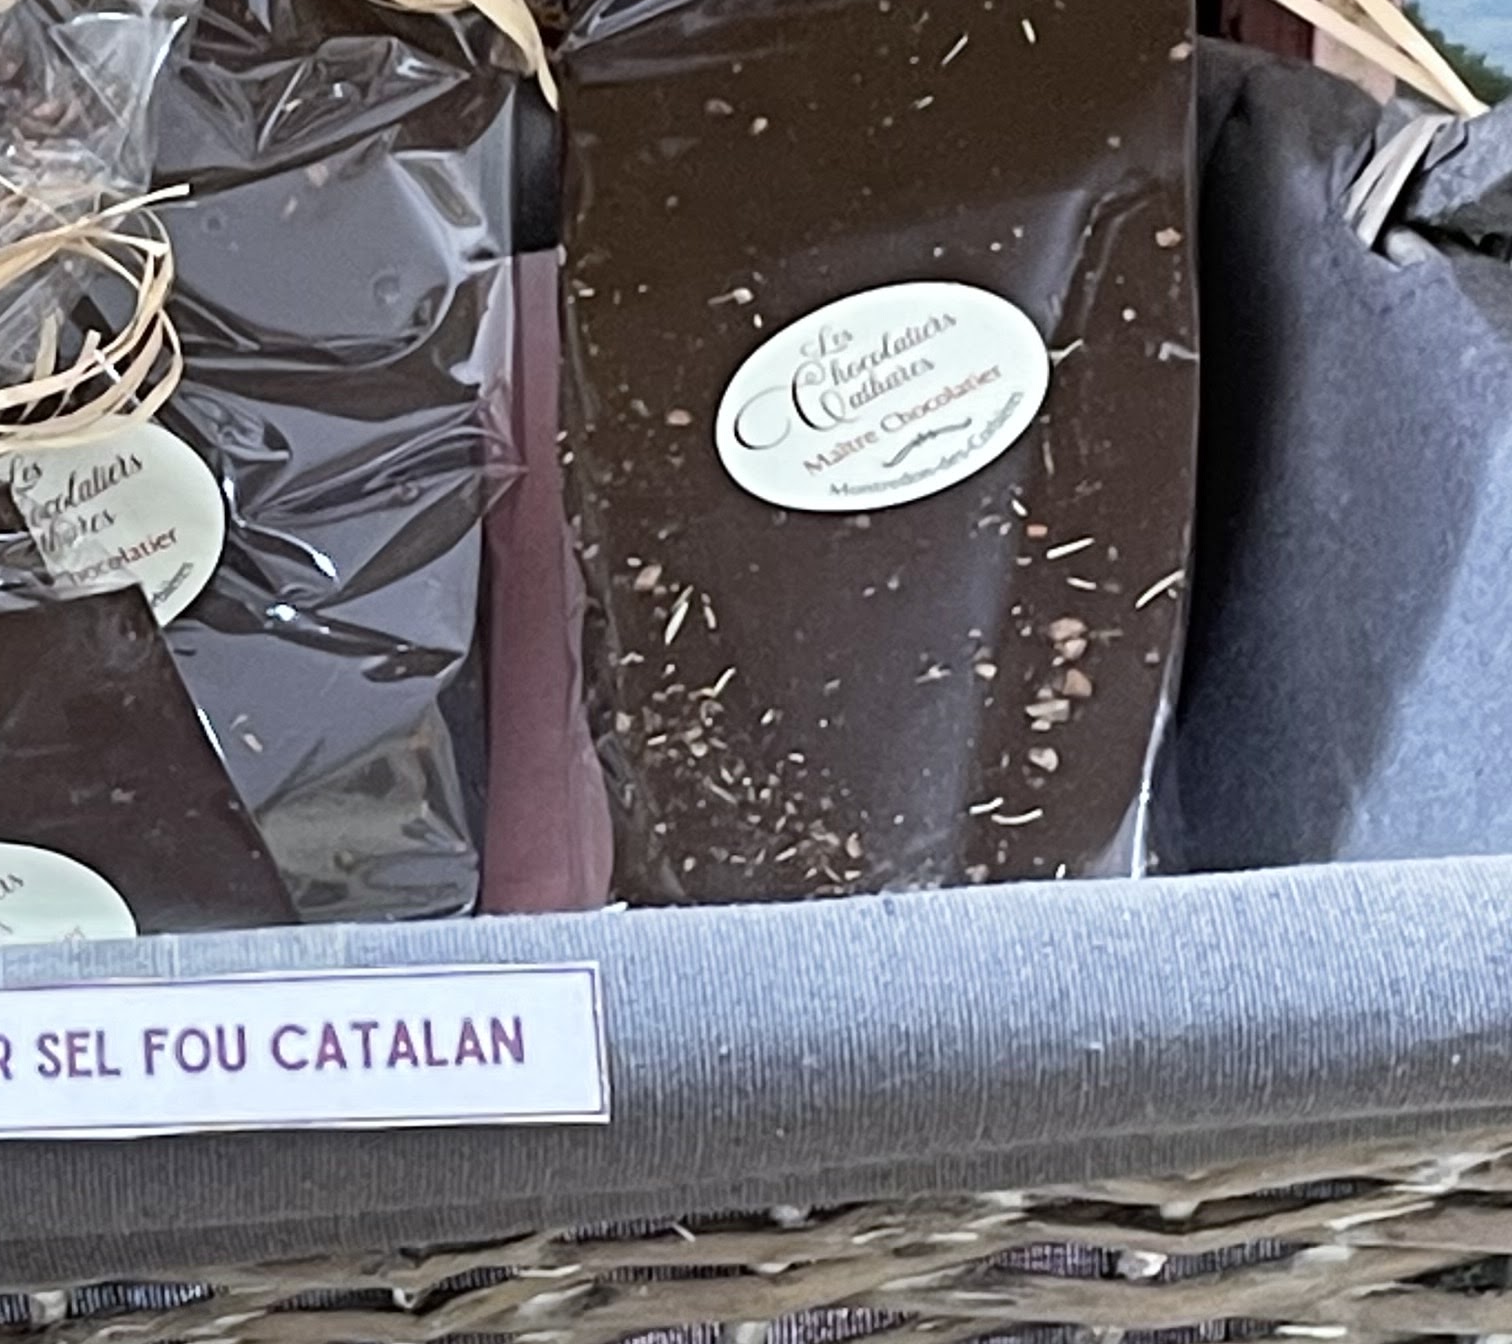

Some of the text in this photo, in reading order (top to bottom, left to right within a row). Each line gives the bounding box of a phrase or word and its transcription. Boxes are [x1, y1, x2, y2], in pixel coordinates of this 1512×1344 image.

[800, 324, 854, 358] Les
[802, 363, 1003, 477] Maître Chocolatier
[819, 357, 936, 432] Cathares
[36, 1028, 122, 1080] SEL
[143, 1023, 247, 1076] FOU
[270, 1014, 526, 1071] CATALAN
